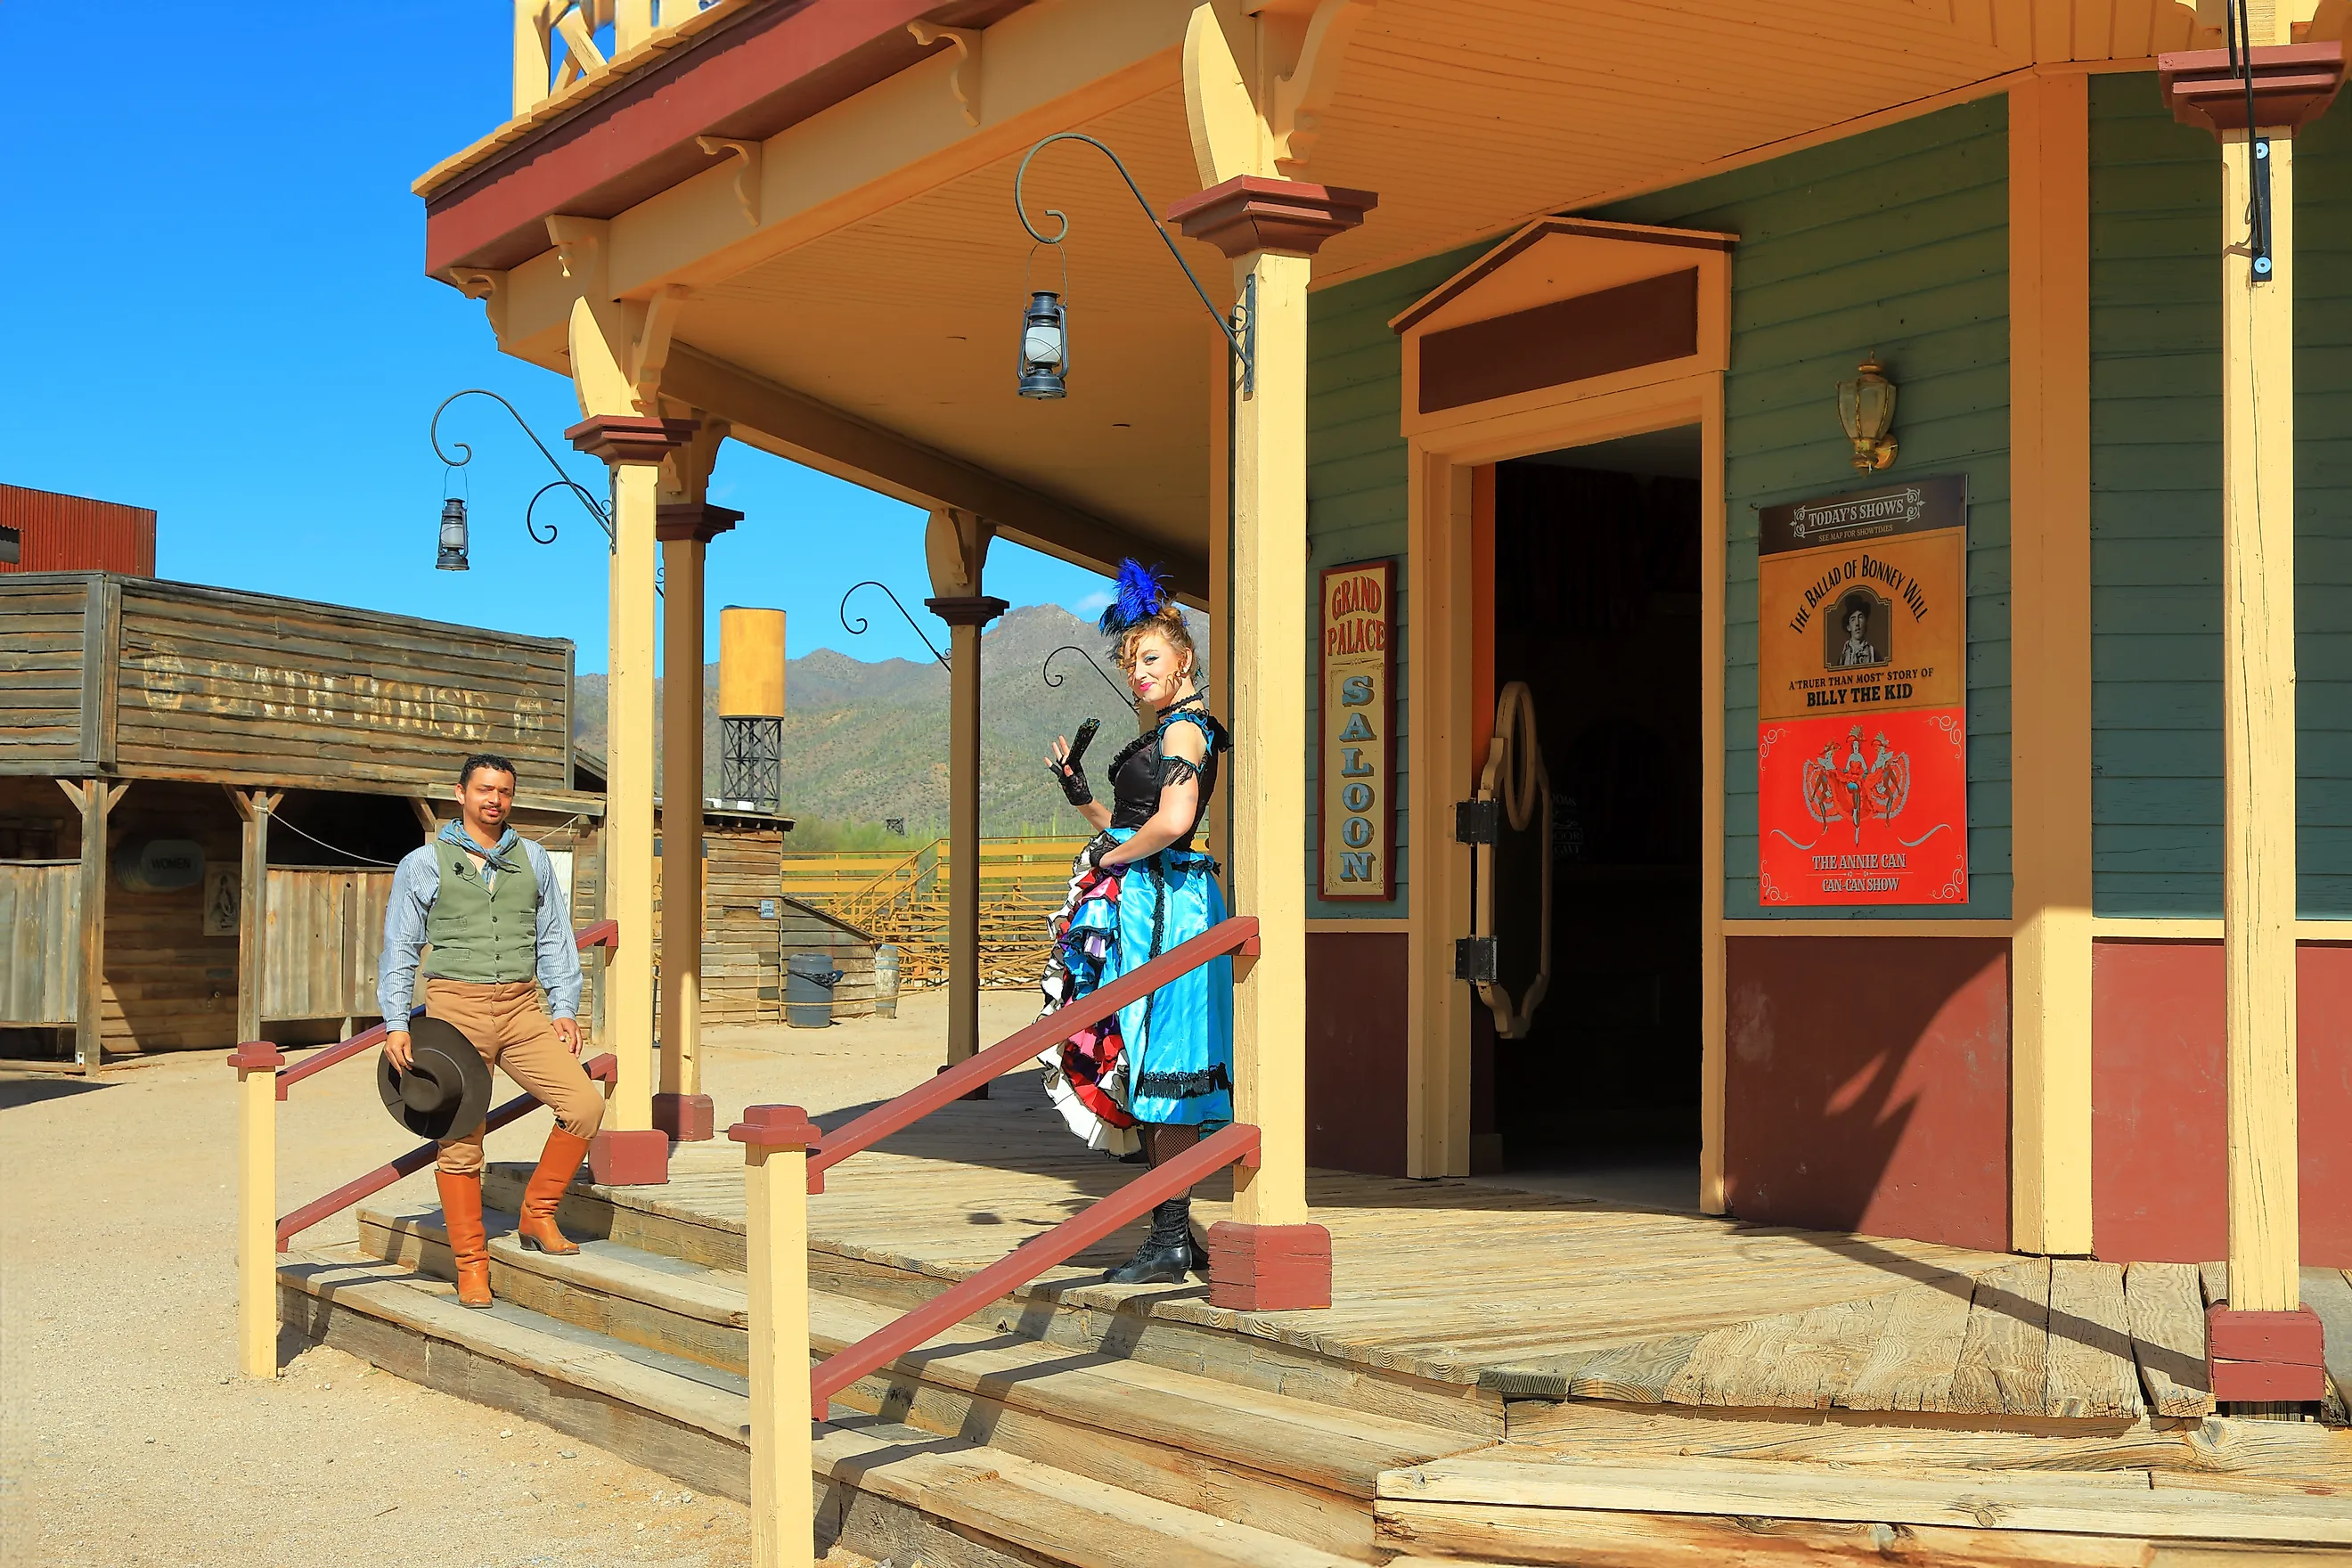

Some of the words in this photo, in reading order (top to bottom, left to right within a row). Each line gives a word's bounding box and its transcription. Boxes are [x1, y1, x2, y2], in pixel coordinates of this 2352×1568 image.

[1809, 506, 1857, 527] TODAY'S
[1859, 498, 1904, 520] SHOWS
[1818, 534, 1829, 543] SEE
[1830, 532, 1842, 541] MAP
[1843, 529, 1856, 538] FOR
[1857, 524, 1893, 536] SHOWTIMES
[1331, 576, 1382, 621] GRAND
[1789, 605, 1811, 634] THE
[1804, 567, 1842, 609] BALLAD
[1843, 559, 1858, 580] OF
[1861, 554, 1907, 591] BONNEY
[1903, 577, 1929, 624] WILL
[1327, 617, 1385, 656] PALACE
[1828, 674, 1853, 687] THAN
[1887, 669, 1918, 681] STORY
[1921, 667, 1934, 678] OF
[209, 660, 337, 722] BATH
[348, 674, 492, 741] HOUSE
[1807, 689, 1848, 707] BILLY
[1850, 685, 1881, 703] THE
[1884, 682, 1913, 700] KID
[1339, 674, 1376, 883] SALOON
[151, 857, 192, 870] WOMEN
[1812, 855, 1838, 870] THE
[1839, 853, 1879, 870] ANNIE
[1881, 853, 1907, 869] CAN
[1822, 878, 1866, 893] CAN-CAN
[1866, 878, 1899, 892] SHOW
